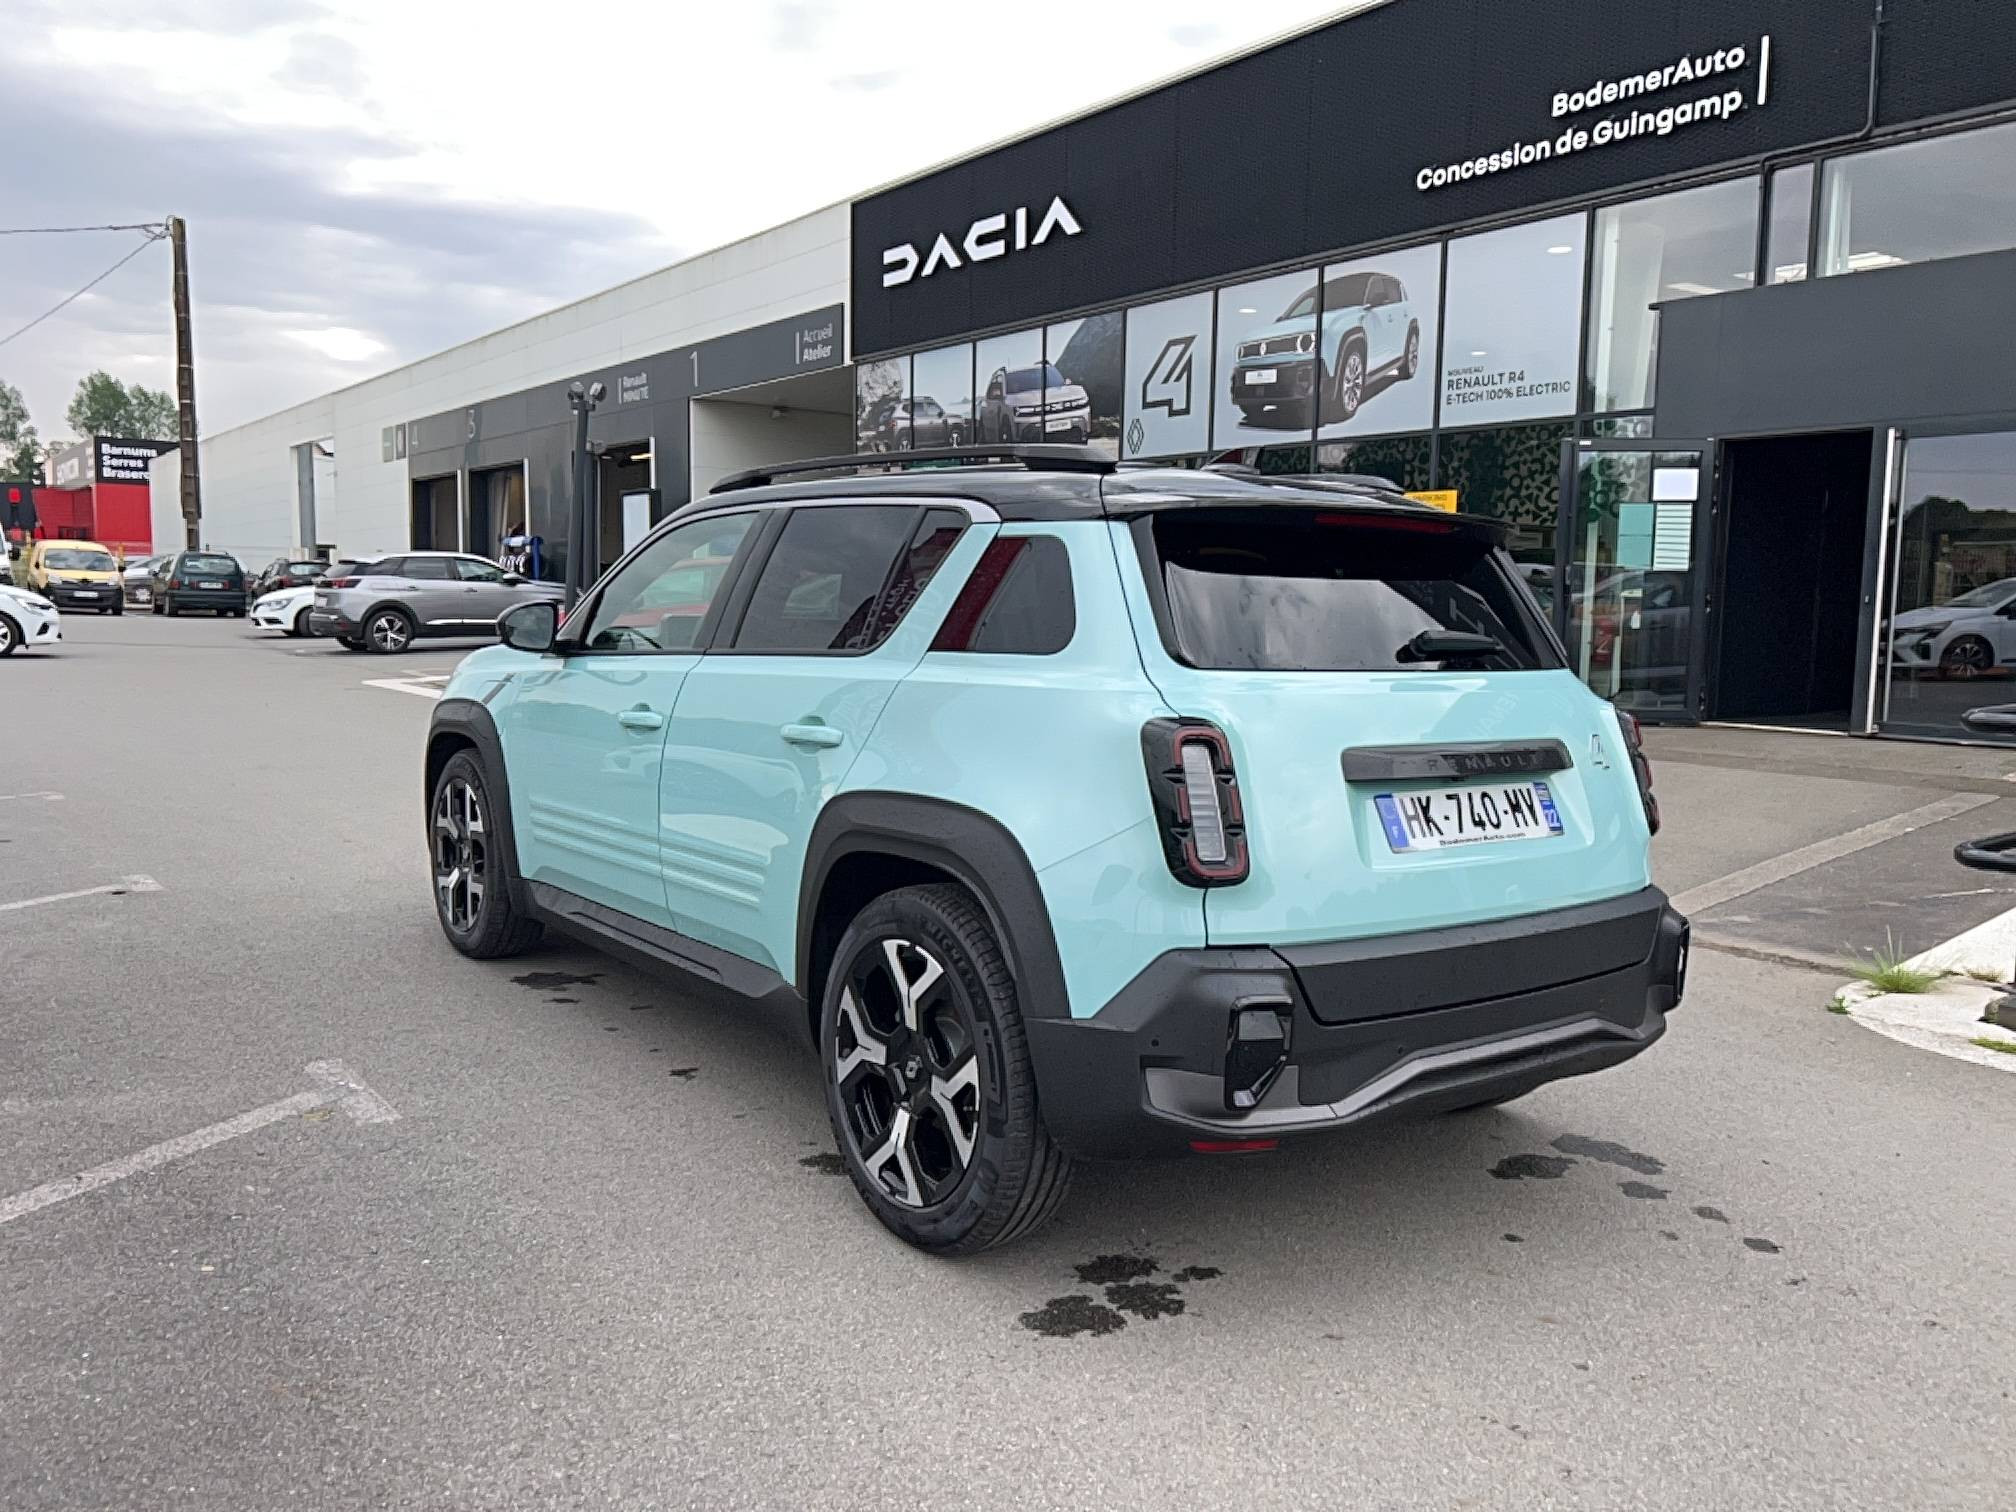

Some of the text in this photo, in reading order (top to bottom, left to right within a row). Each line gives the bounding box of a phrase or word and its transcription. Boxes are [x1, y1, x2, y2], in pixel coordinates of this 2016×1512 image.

[1551, 46, 1746, 117] BodemerAuto
[1416, 89, 1743, 190] Concession de Guingamp
[882, 195, 1082, 288] DACIA
[803, 323, 833, 343] Accueil
[803, 344, 832, 362] Atelier
[689, 351, 699, 387] 1
[1447, 370, 1525, 391] RENAULT R4
[1446, 380, 1571, 406] E-TECH 100% ELECTRIC
[101, 443, 158, 457] Barnums
[102, 455, 144, 468] Serres
